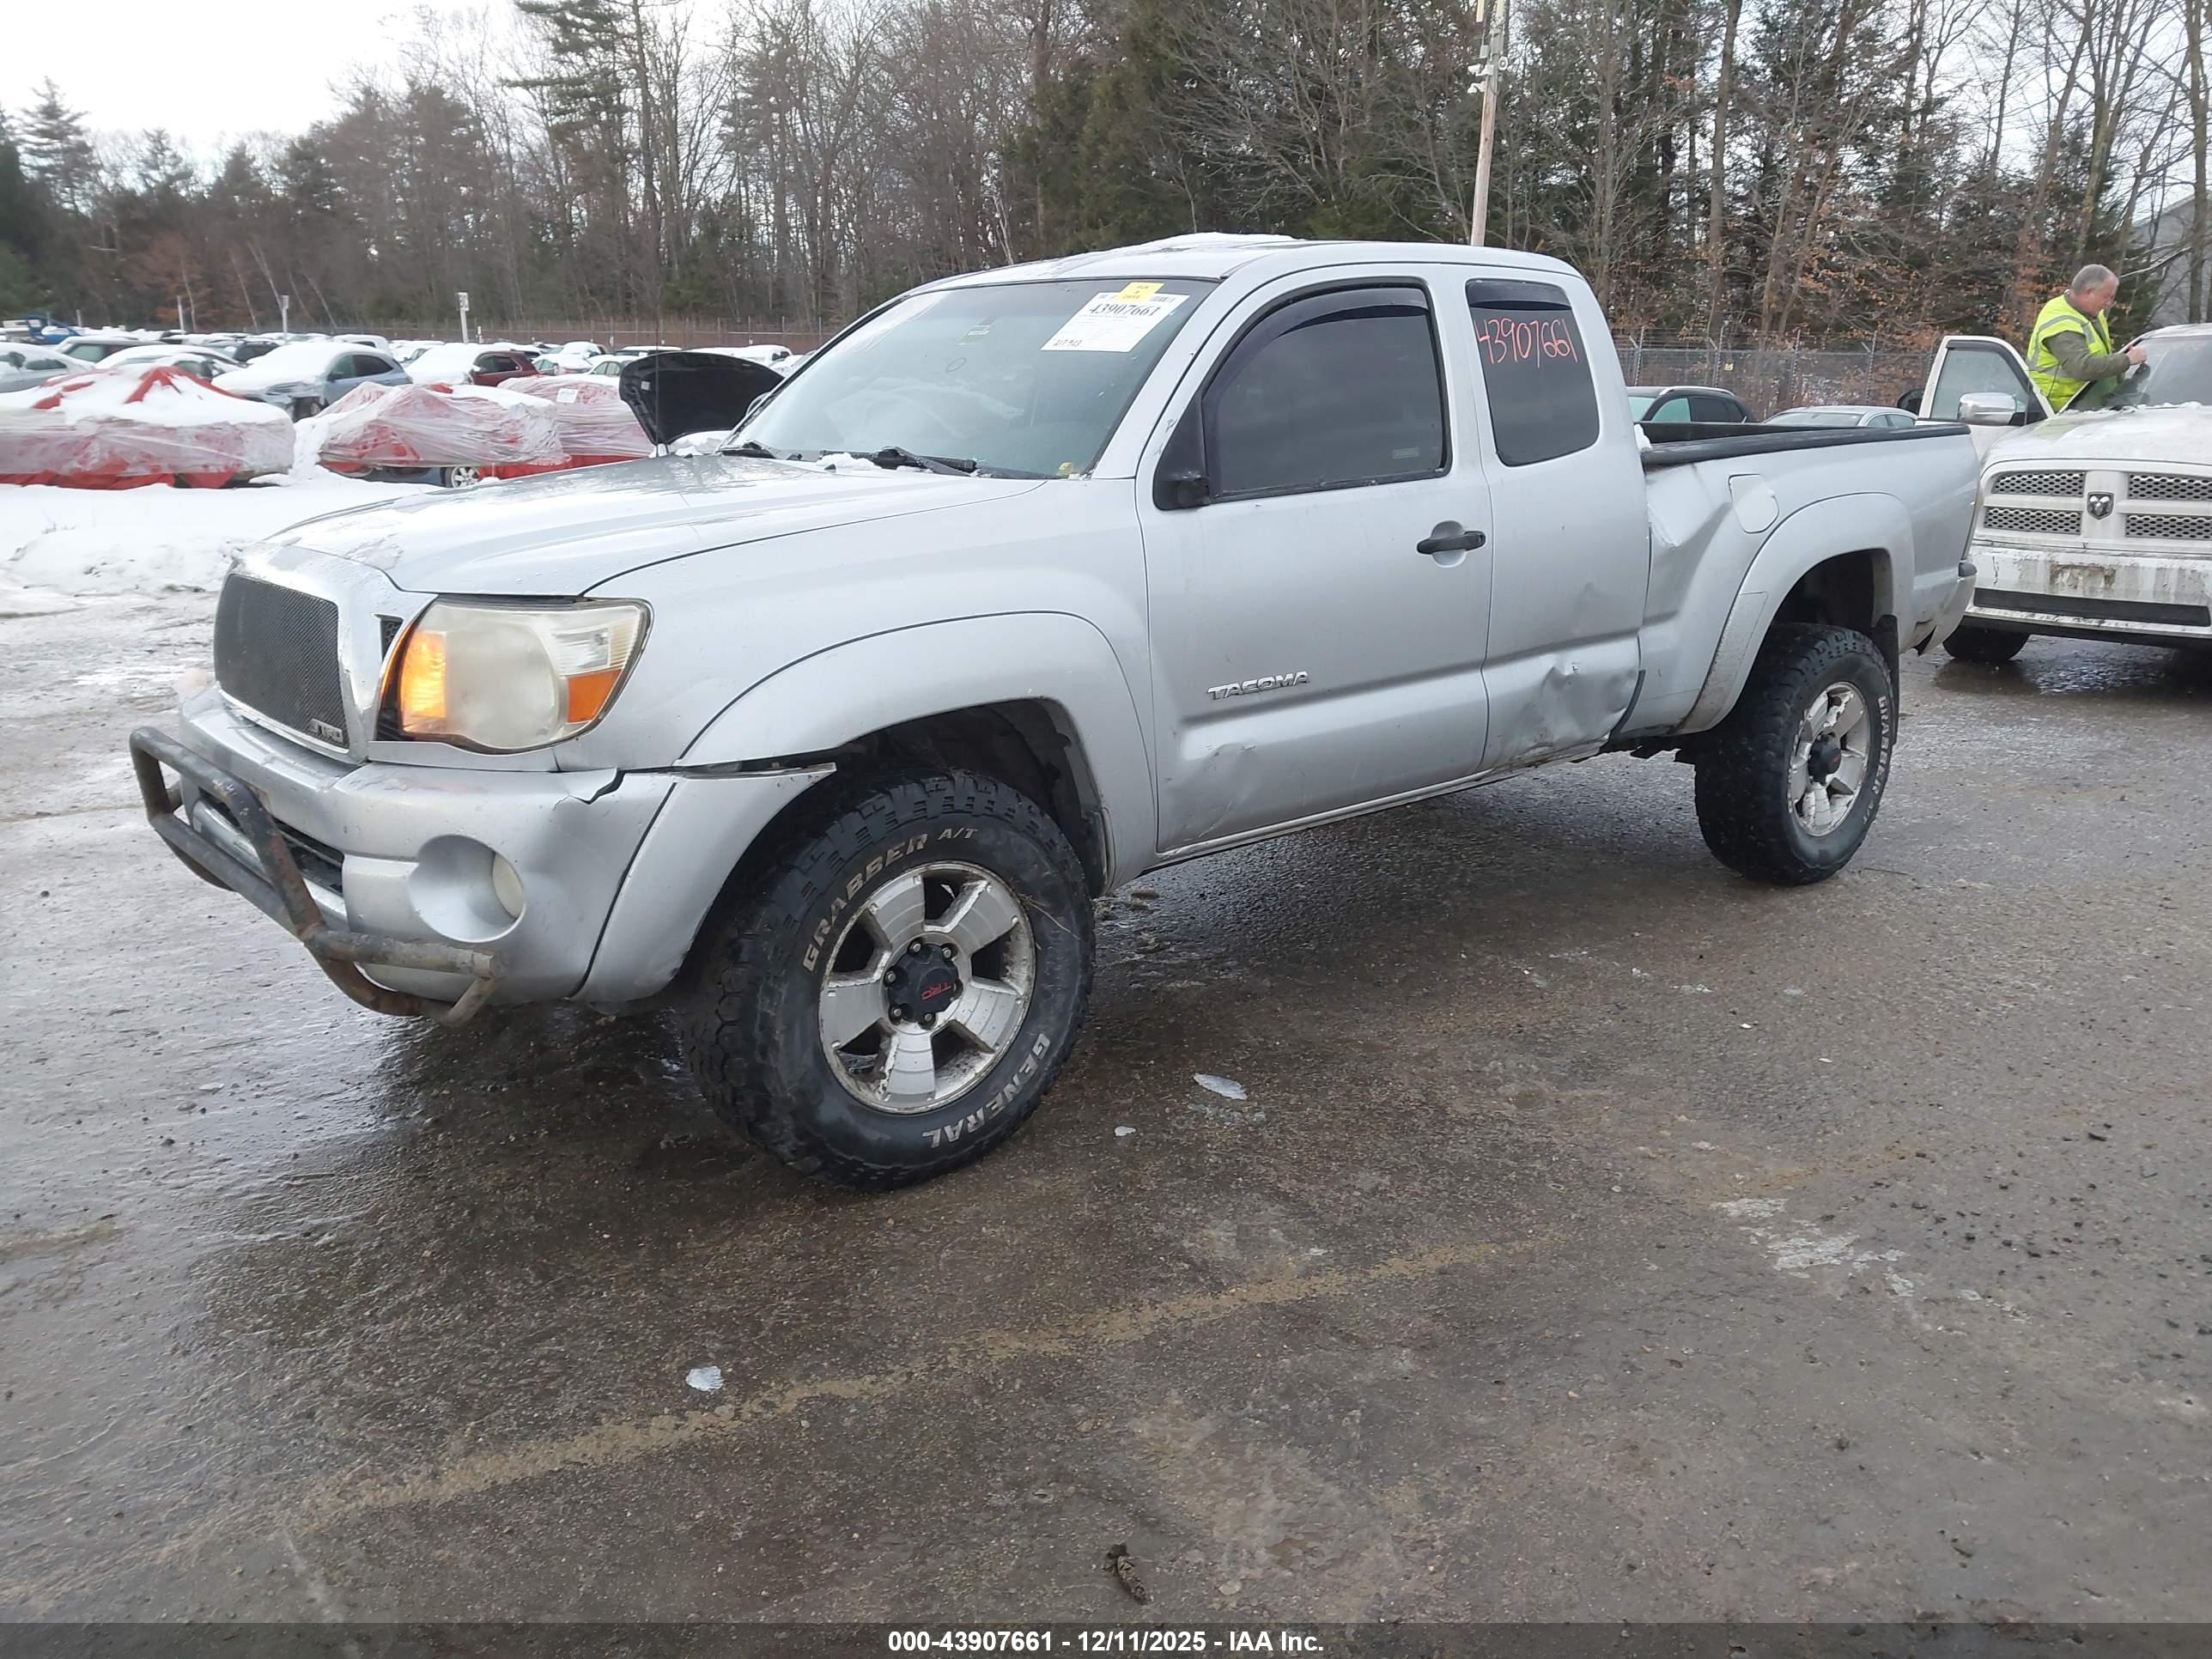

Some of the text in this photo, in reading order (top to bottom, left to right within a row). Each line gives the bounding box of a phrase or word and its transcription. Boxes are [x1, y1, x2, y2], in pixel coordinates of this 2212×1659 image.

[1089, 303, 1161, 316] 43907661
[1474, 317, 1578, 368] 43907661
[1207, 671, 1310, 700] TACOMA
[1872, 696, 1889, 795] GRABBER
[803, 827, 978, 972] GRABBER A/T
[922, 1033, 1051, 1149] GENERAL
